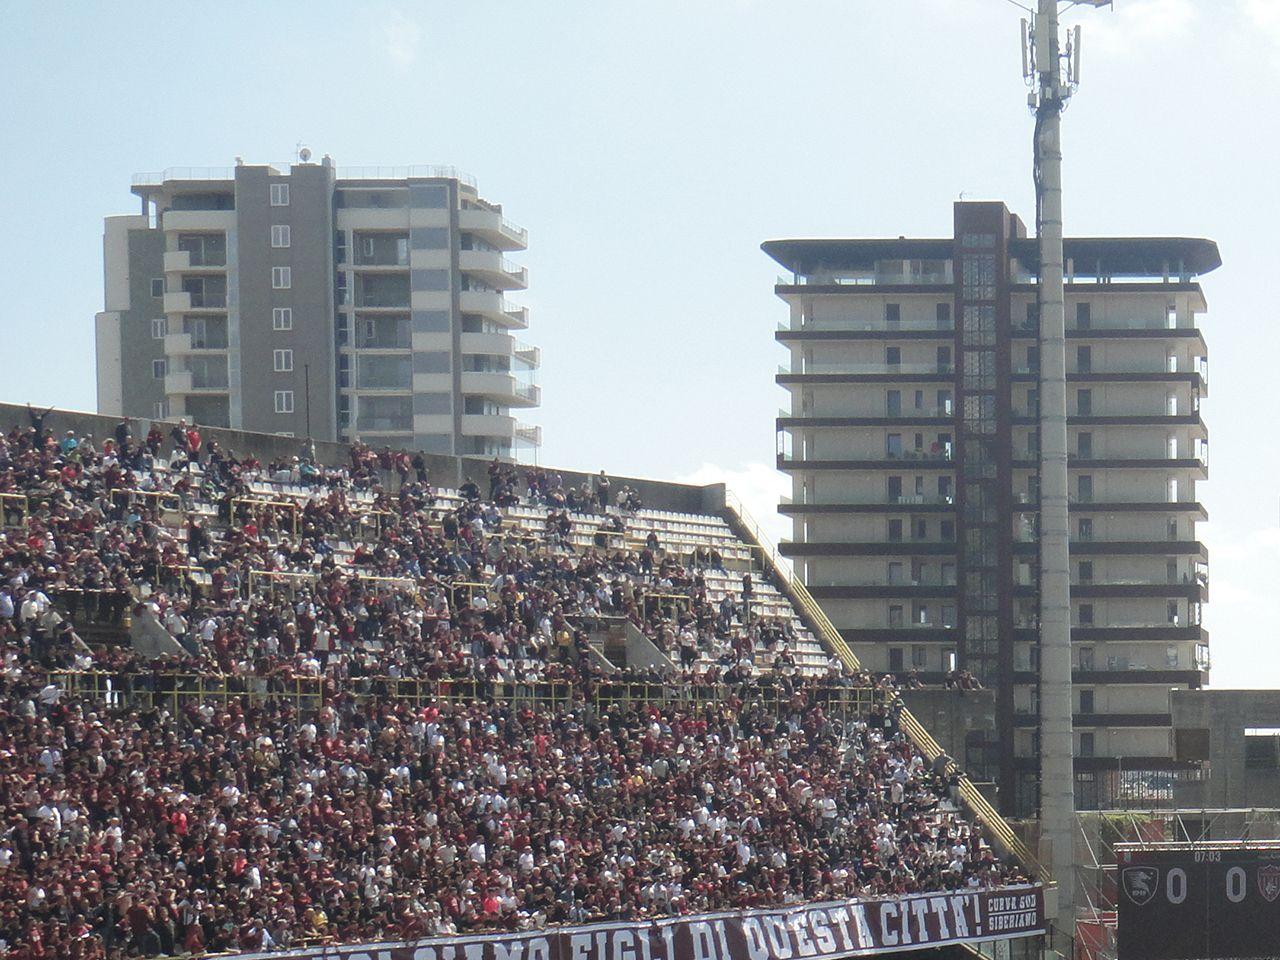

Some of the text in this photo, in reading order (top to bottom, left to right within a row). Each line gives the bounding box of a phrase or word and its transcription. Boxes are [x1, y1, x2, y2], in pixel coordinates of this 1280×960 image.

[1194, 851, 1222, 863] 07:03
[1166, 867, 1187, 904] 0
[1226, 866, 1247, 903] 0
[988, 897, 1017, 912] CURVA
[988, 912, 1037, 931] SIBERIANO
